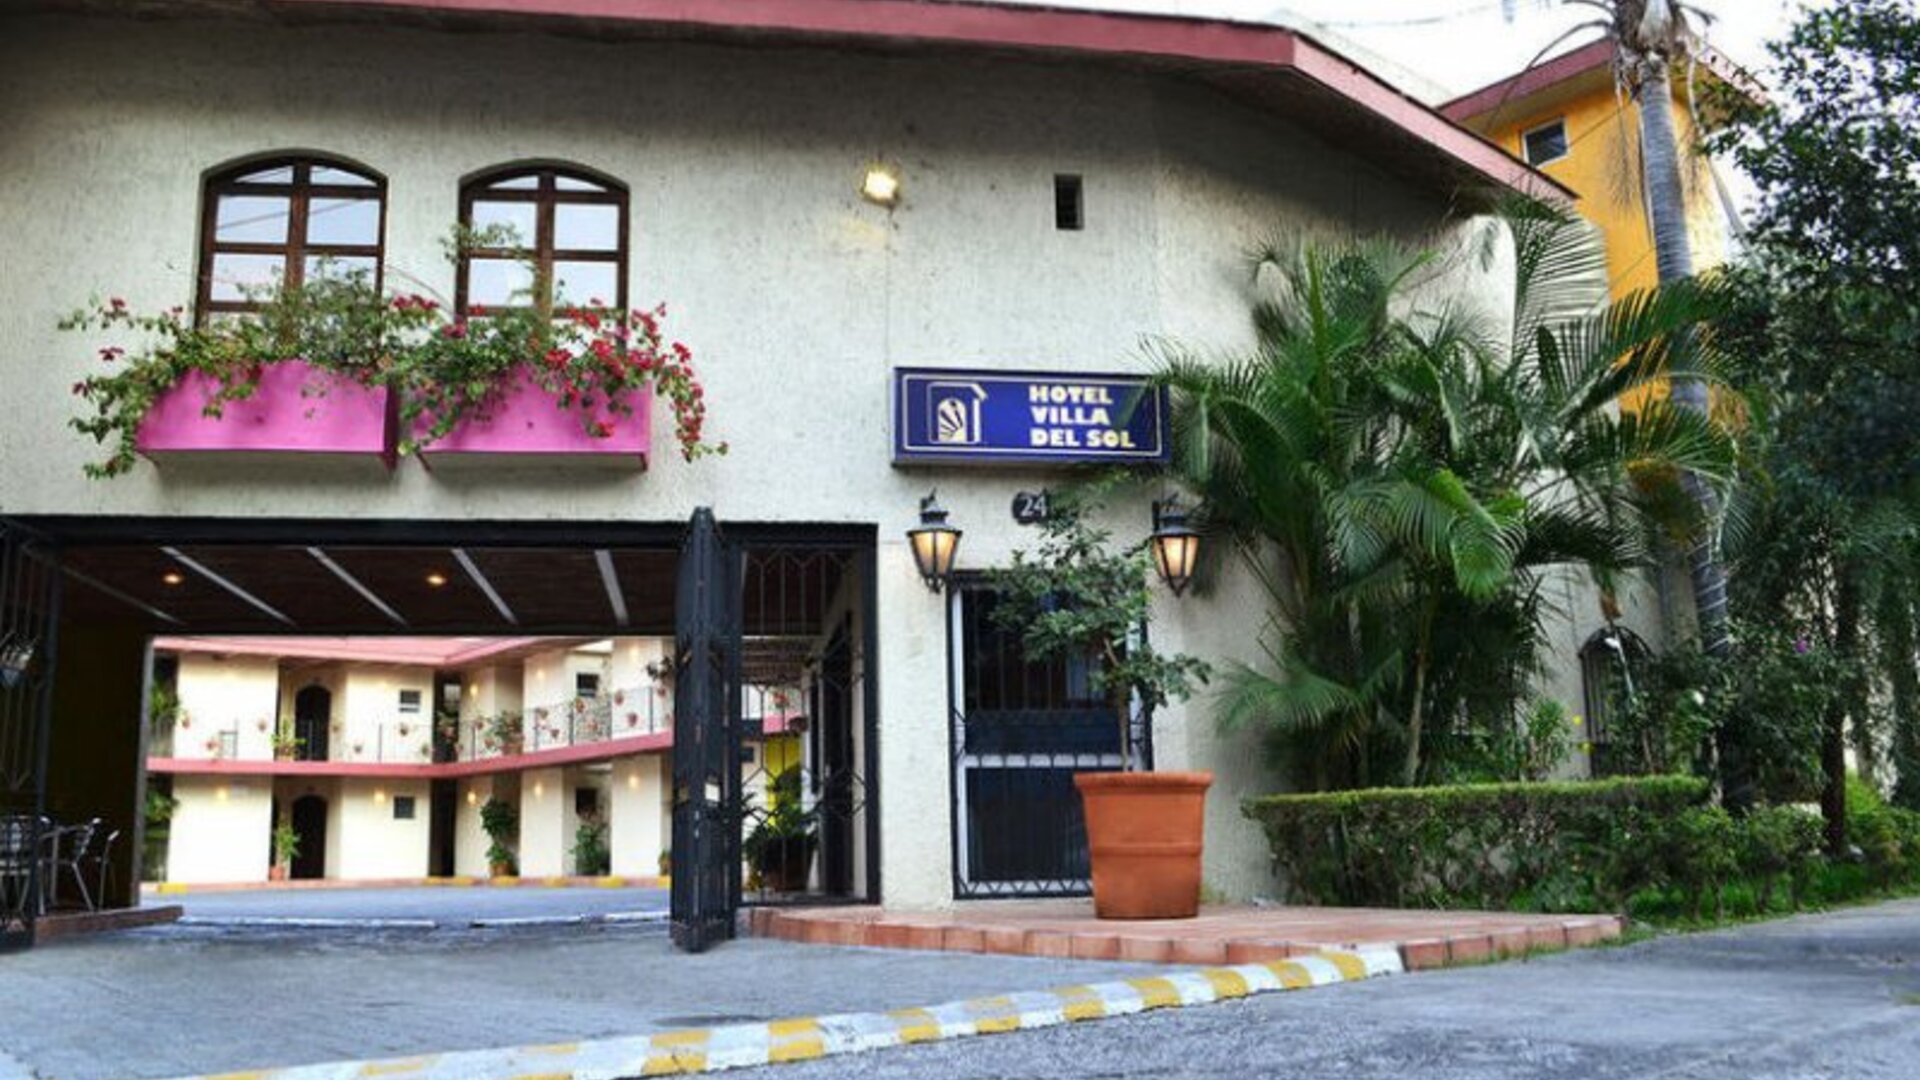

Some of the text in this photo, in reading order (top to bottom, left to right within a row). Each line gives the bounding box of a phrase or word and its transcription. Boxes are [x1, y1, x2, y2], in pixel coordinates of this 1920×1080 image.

[1029, 385, 1113, 404] HOTEL
[1030, 407, 1110, 425] VILLA
[1030, 429, 1136, 448] DEL SOL
